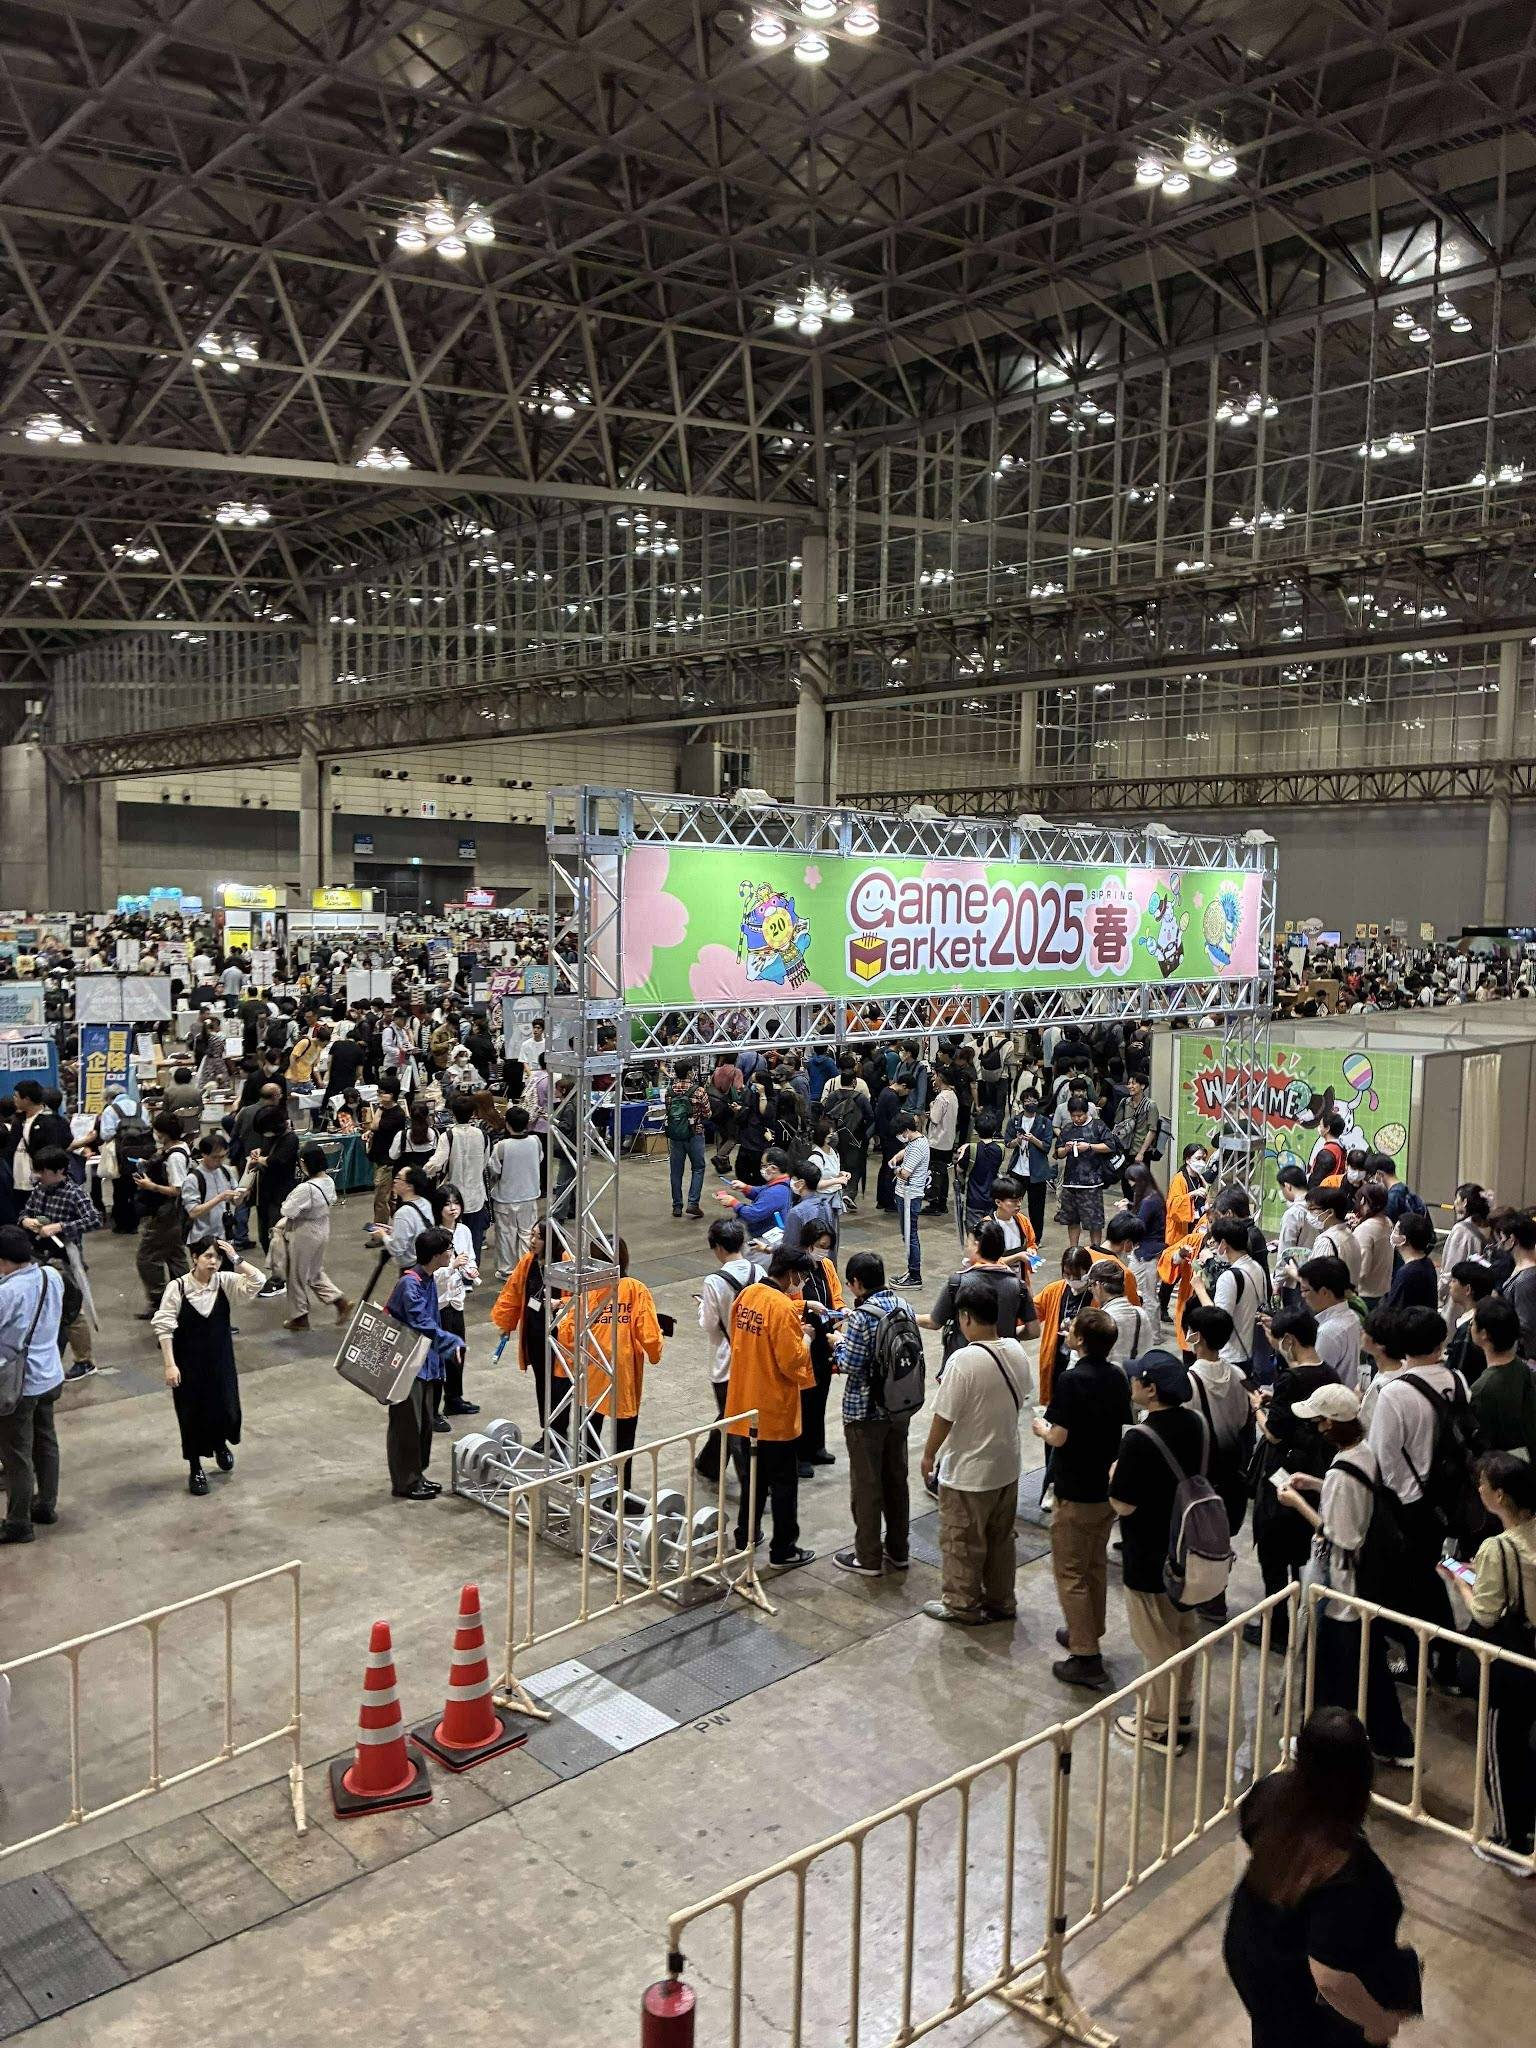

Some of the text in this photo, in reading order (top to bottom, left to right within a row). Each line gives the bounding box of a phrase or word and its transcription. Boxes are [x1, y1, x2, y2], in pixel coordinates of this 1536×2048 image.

[1091, 890, 1133, 900] SPRING
[770, 917, 786, 937] 20
[850, 872, 1084, 966] Game 2025
[1093, 904, 1128, 963] 春
[736, 1320, 762, 1337] arket
[694, 1713, 731, 1733] PW
